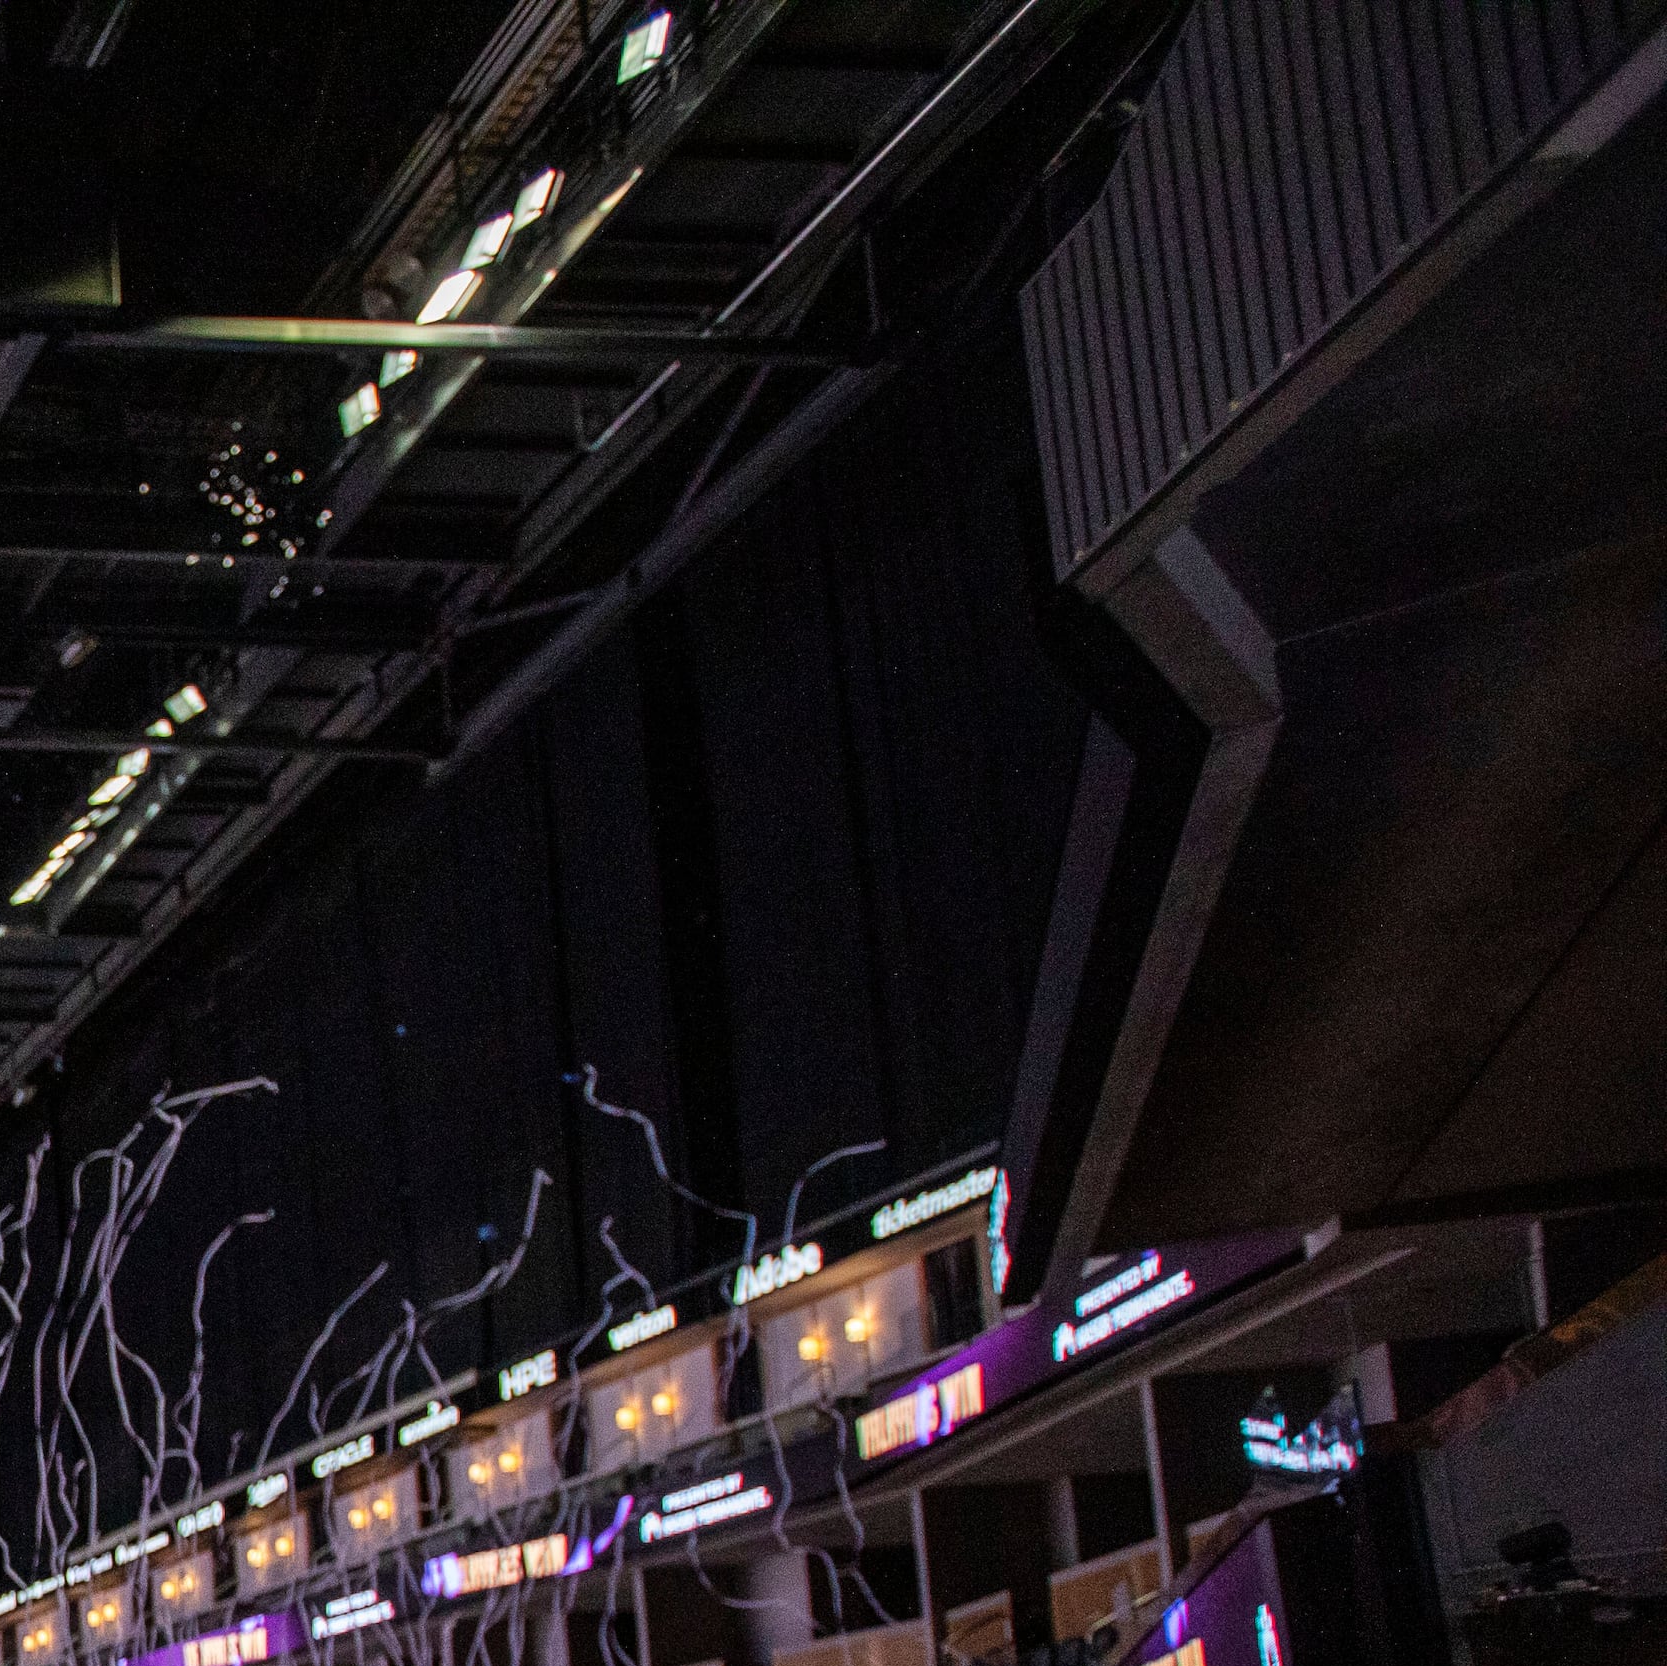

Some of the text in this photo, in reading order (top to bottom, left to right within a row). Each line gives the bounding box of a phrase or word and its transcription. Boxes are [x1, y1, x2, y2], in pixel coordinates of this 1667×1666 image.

[871, 1166, 998, 1239] ticketmaster
[733, 1242, 824, 1306] Adobe
[608, 1304, 677, 1351] verizon
[499, 1349, 557, 1401] HPE
